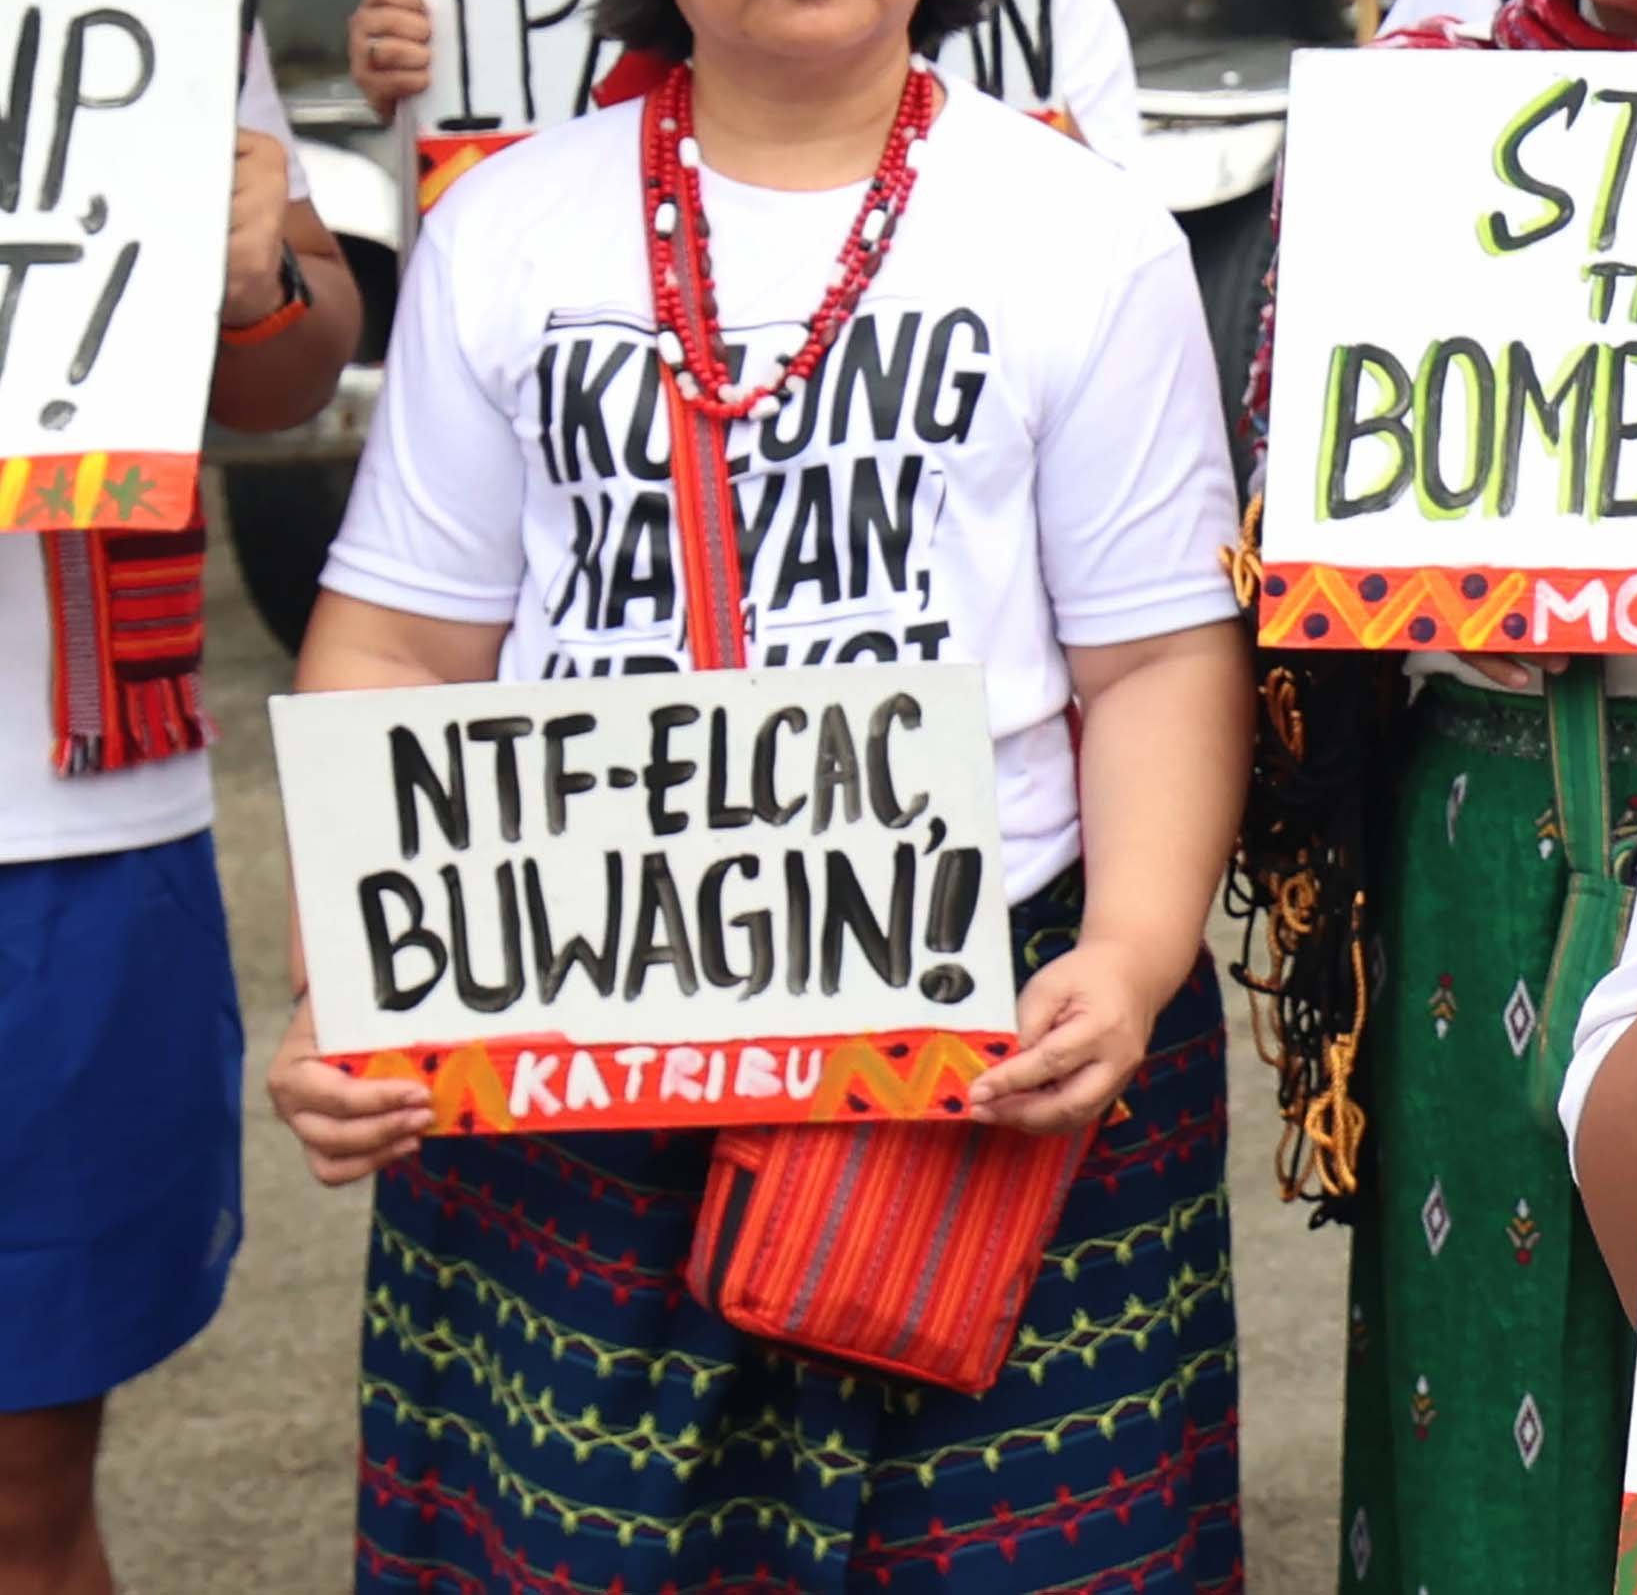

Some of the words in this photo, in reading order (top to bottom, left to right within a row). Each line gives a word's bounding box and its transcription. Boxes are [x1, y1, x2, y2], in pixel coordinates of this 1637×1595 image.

[387, 692, 946, 859] NTF-ELCAC,
[357, 841, 983, 1013] BUWAGIN!
[508, 1048, 824, 1118] KATRIBU
